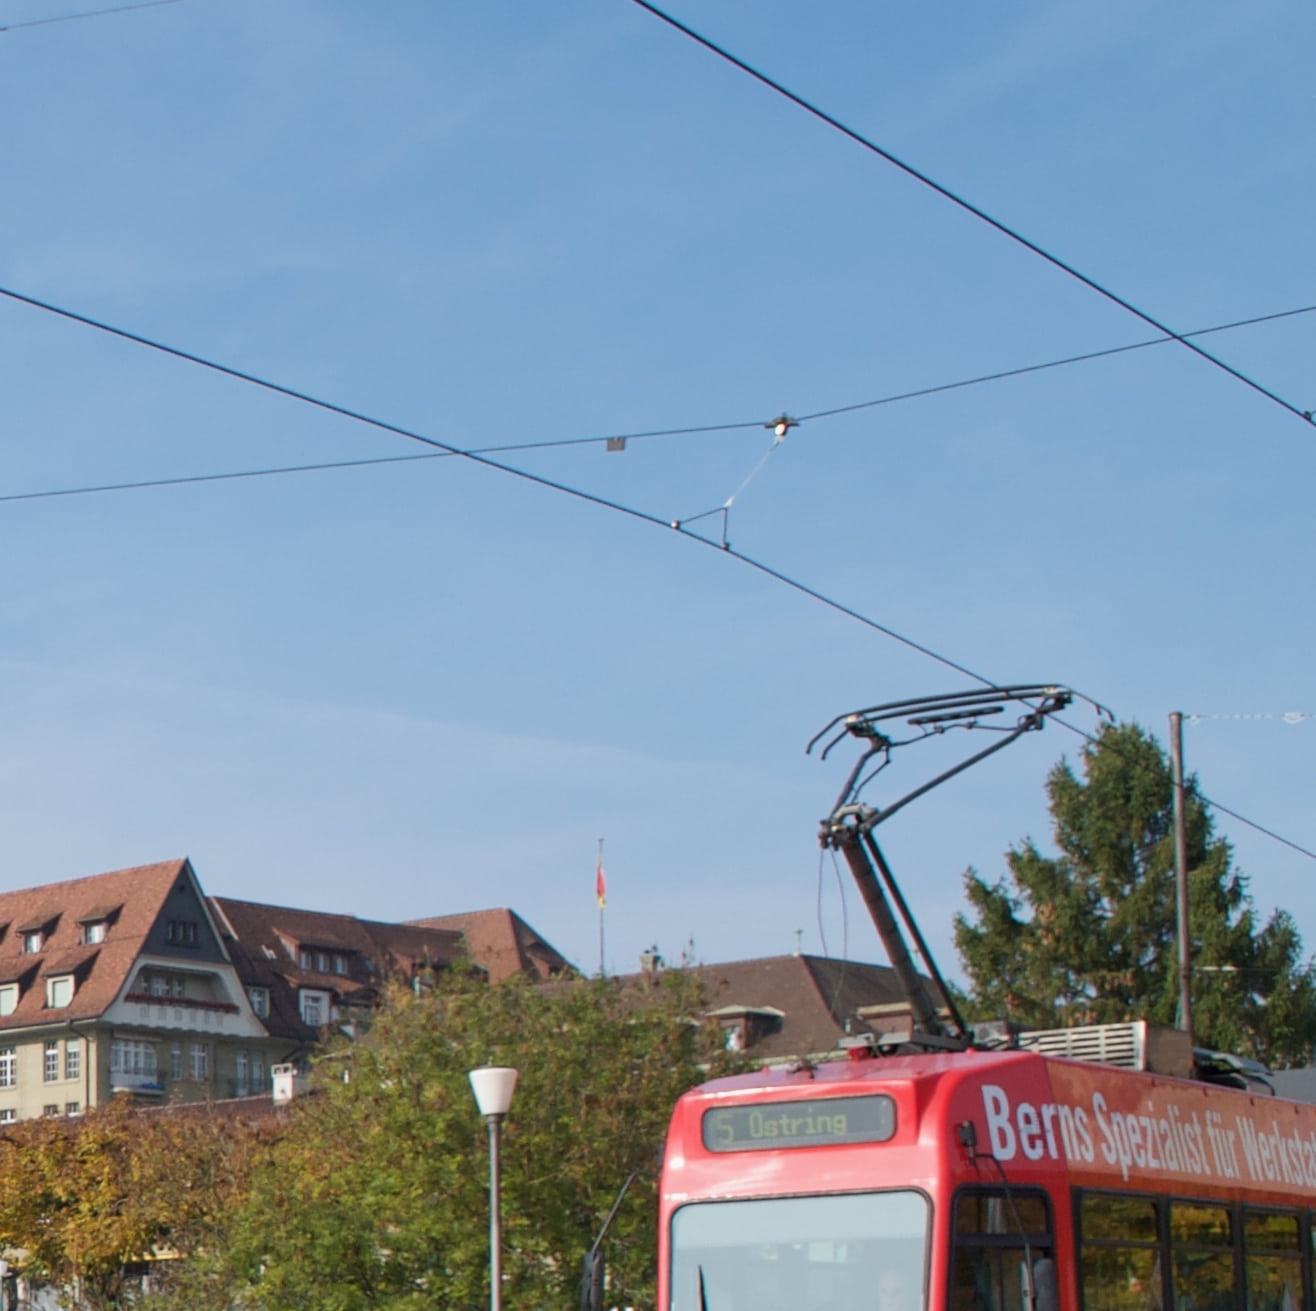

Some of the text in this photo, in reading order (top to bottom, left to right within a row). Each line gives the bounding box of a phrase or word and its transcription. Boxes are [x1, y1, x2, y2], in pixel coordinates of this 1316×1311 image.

[717, 1107, 847, 1144] 5 Ostring
[981, 1084, 1094, 1163] Berns
[1092, 1091, 1211, 1182] Spezialist
[1205, 1110, 1240, 1179] für
